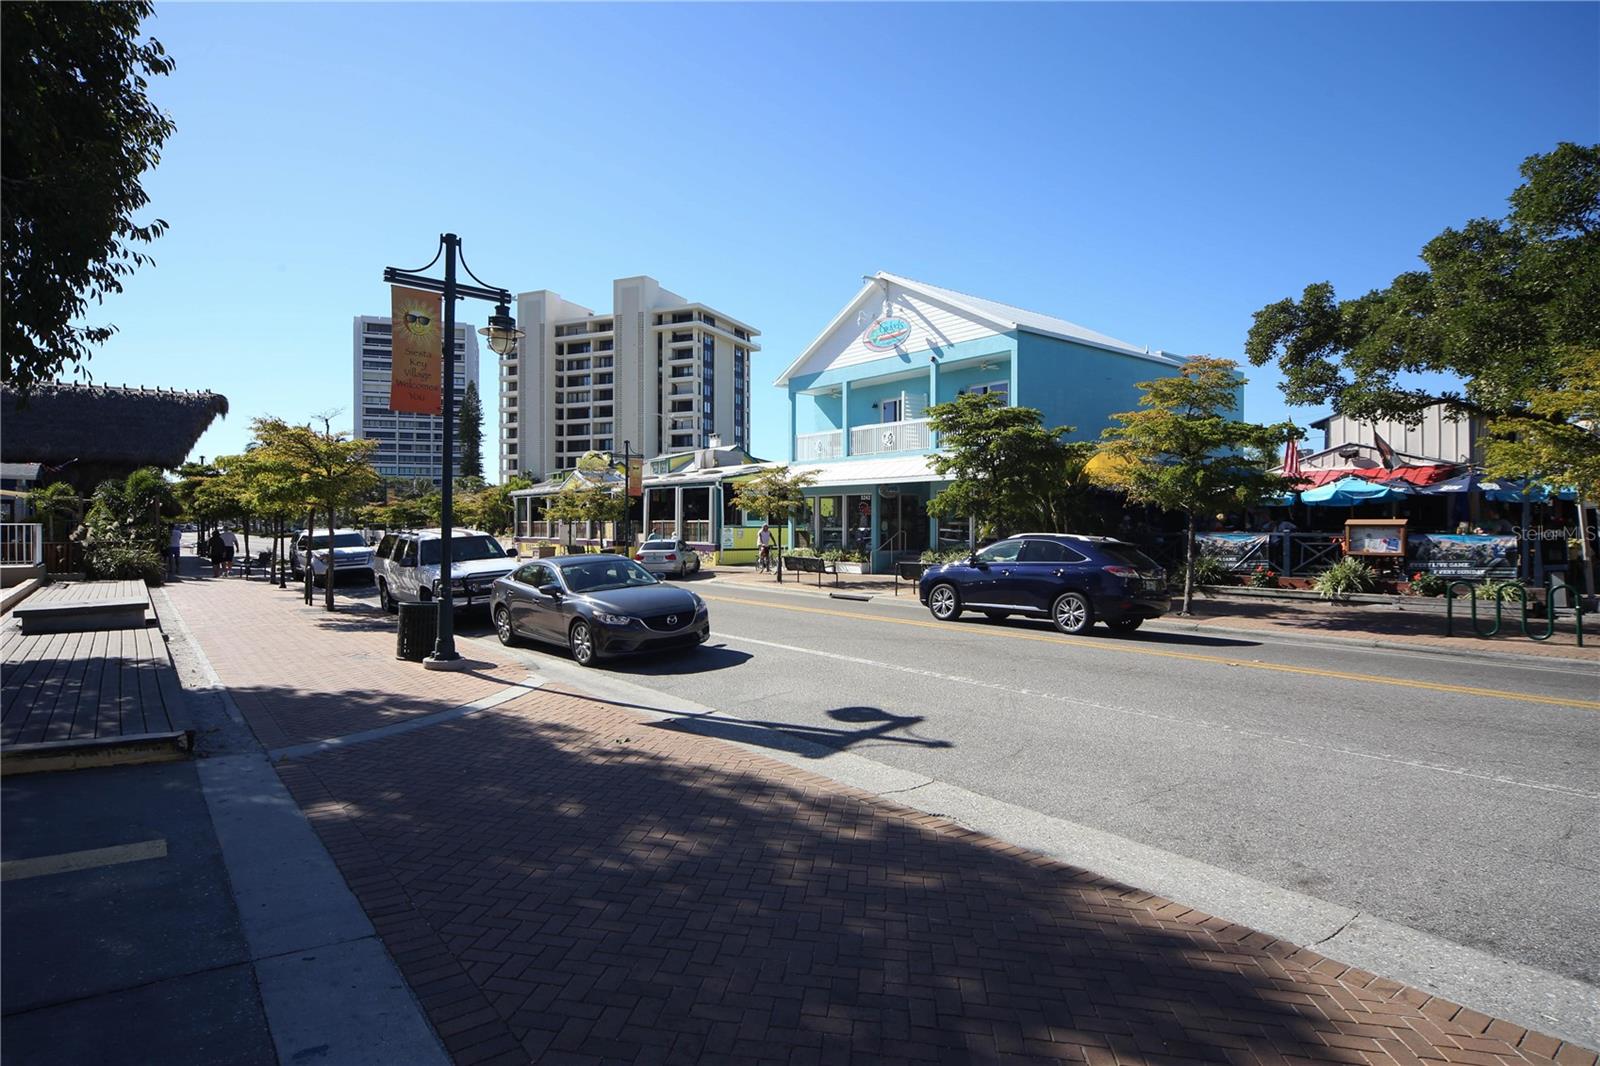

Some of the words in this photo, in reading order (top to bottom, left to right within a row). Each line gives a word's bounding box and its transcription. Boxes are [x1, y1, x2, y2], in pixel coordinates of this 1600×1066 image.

[405, 348, 432, 358] Siesta
[409, 358, 427, 370] Key
[404, 367, 432, 381] Village
[408, 392, 425, 401] You
